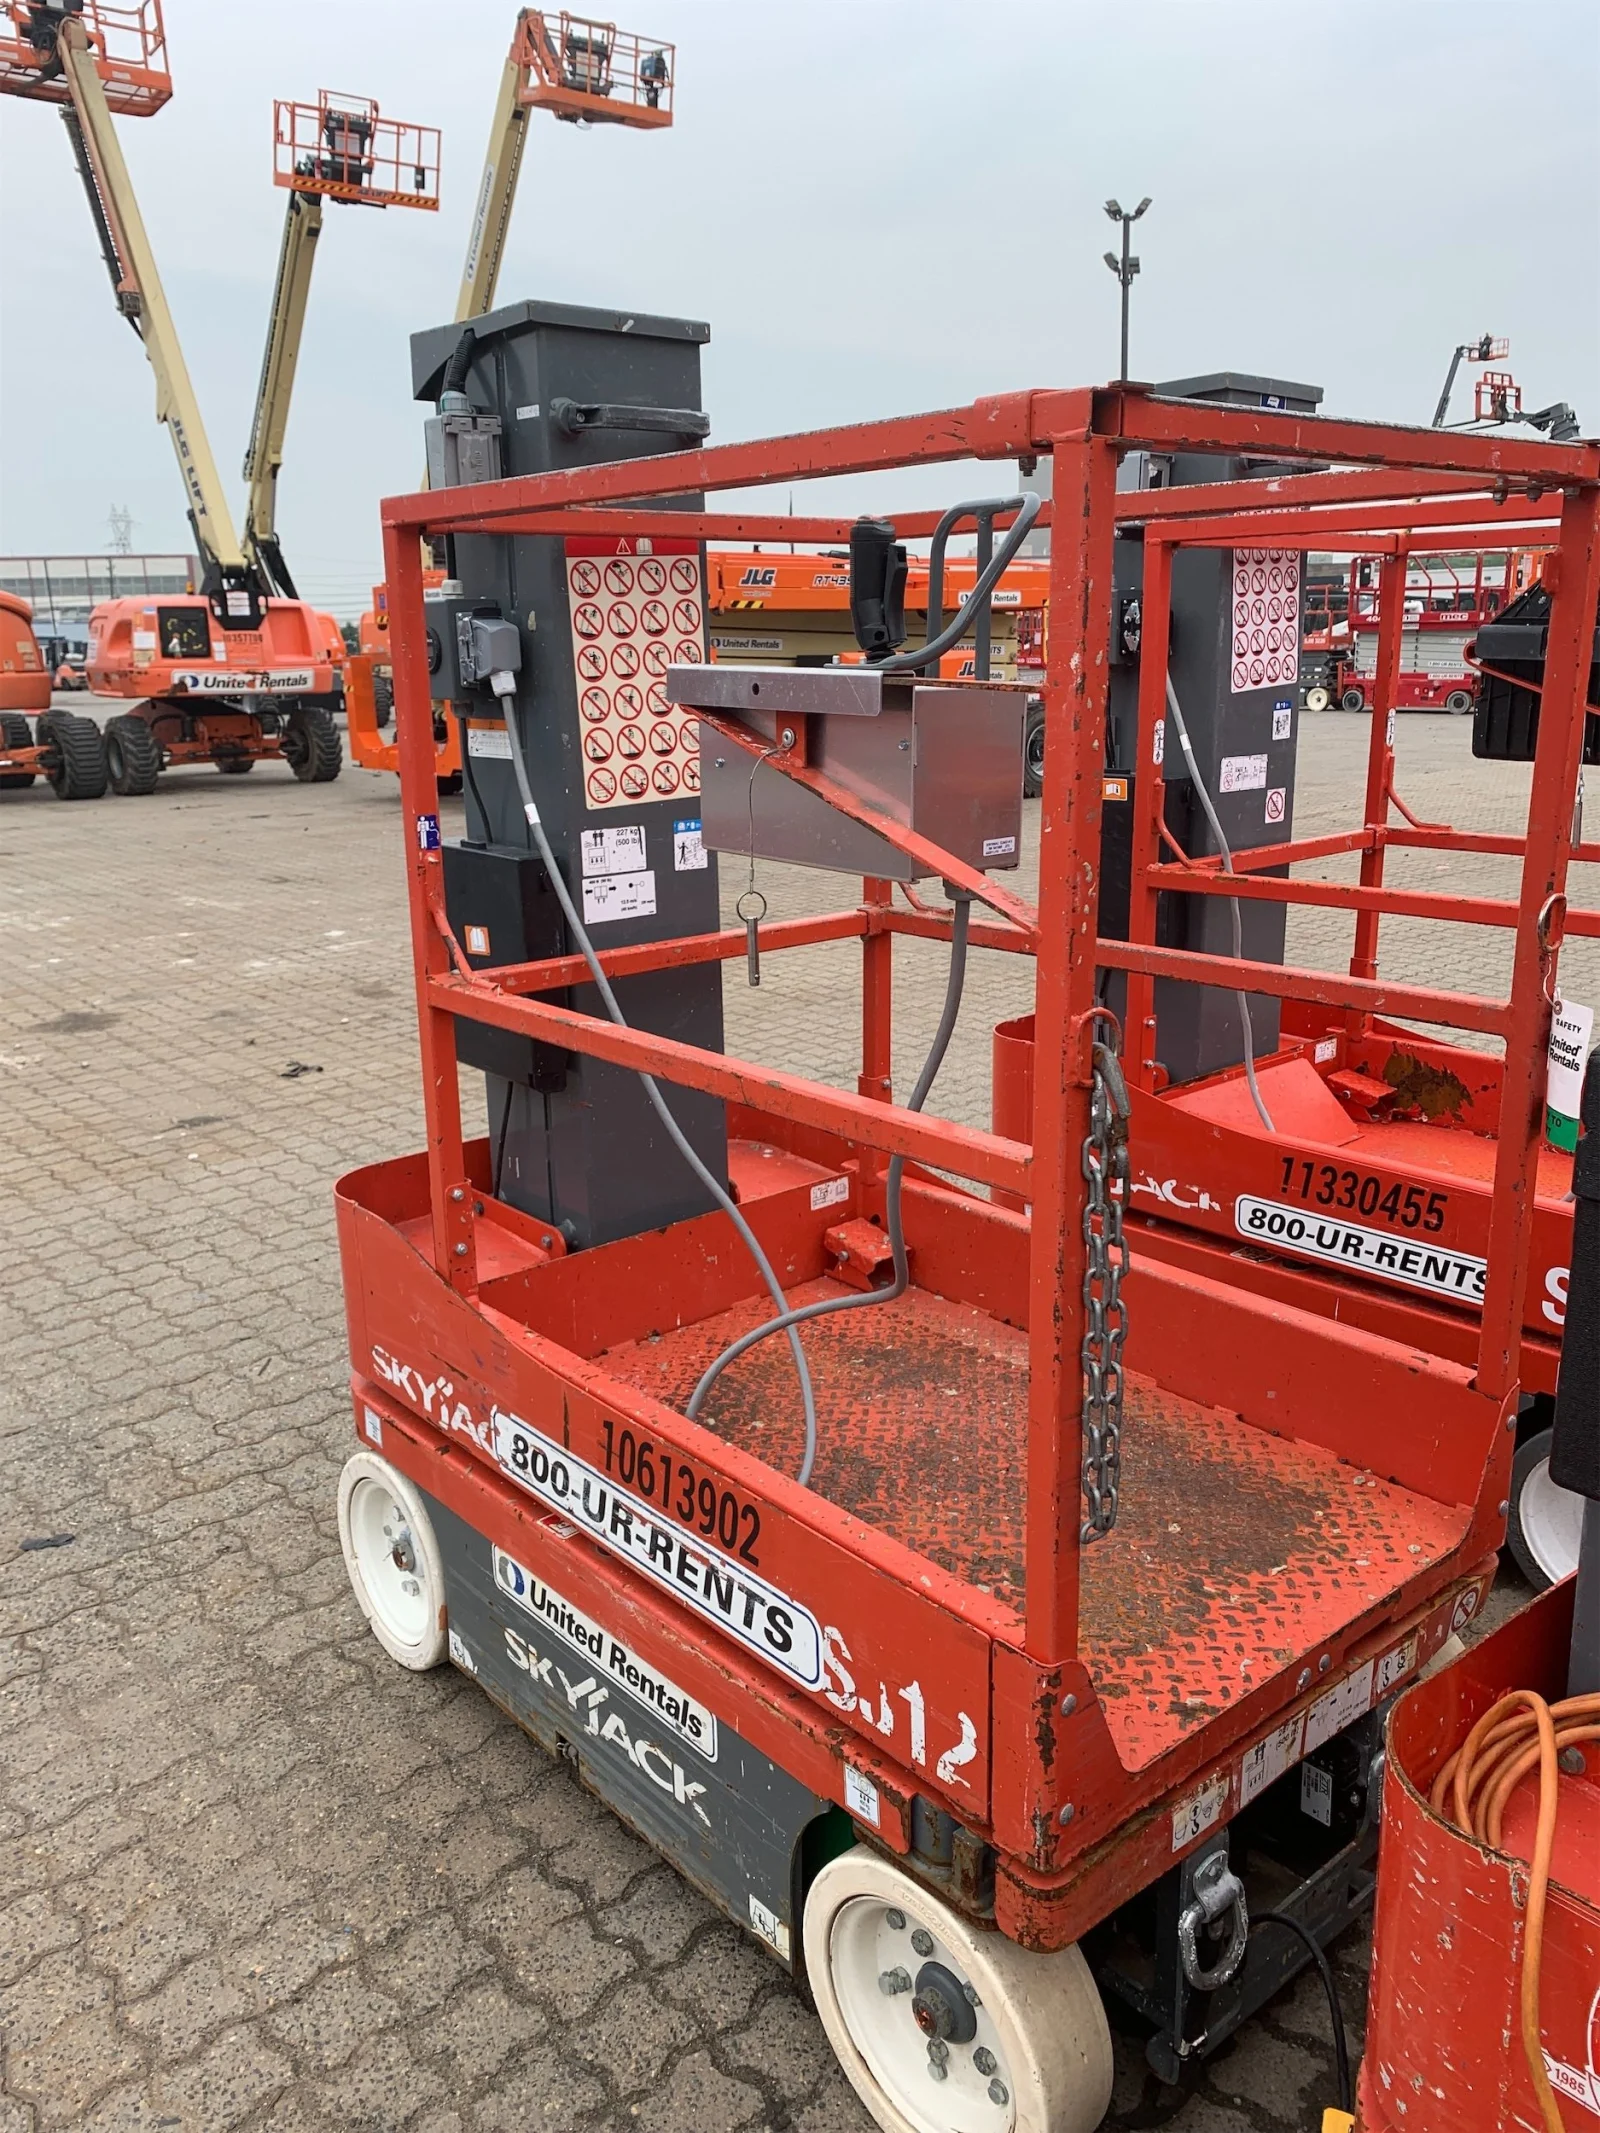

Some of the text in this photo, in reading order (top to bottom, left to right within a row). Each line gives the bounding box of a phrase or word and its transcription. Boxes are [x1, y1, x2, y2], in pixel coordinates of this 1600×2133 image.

[172, 417, 207, 516] JLG LIFT
[740, 568, 776, 586] JLG
[993, 593, 1018, 602] Rentals
[722, 639, 780, 650] United Rentals
[958, 662, 975, 676] JL
[259, 674, 308, 688] Rentals
[616, 838, 630, 847] (500
[1556, 1018, 1582, 1033] SAFETY
[1550, 1033, 1580, 1056] United
[1549, 1048, 1581, 1072] Rentals
[1280, 1156, 1448, 1232] 11330455
[602, 1420, 760, 1568] 10613902
[510, 1433, 794, 1653] 800-UR-RENTS
[529, 1580, 703, 1738] United Rentals
[504, 1627, 712, 1827] SKYJACK
[1555, 2068, 1586, 2096] 1985
